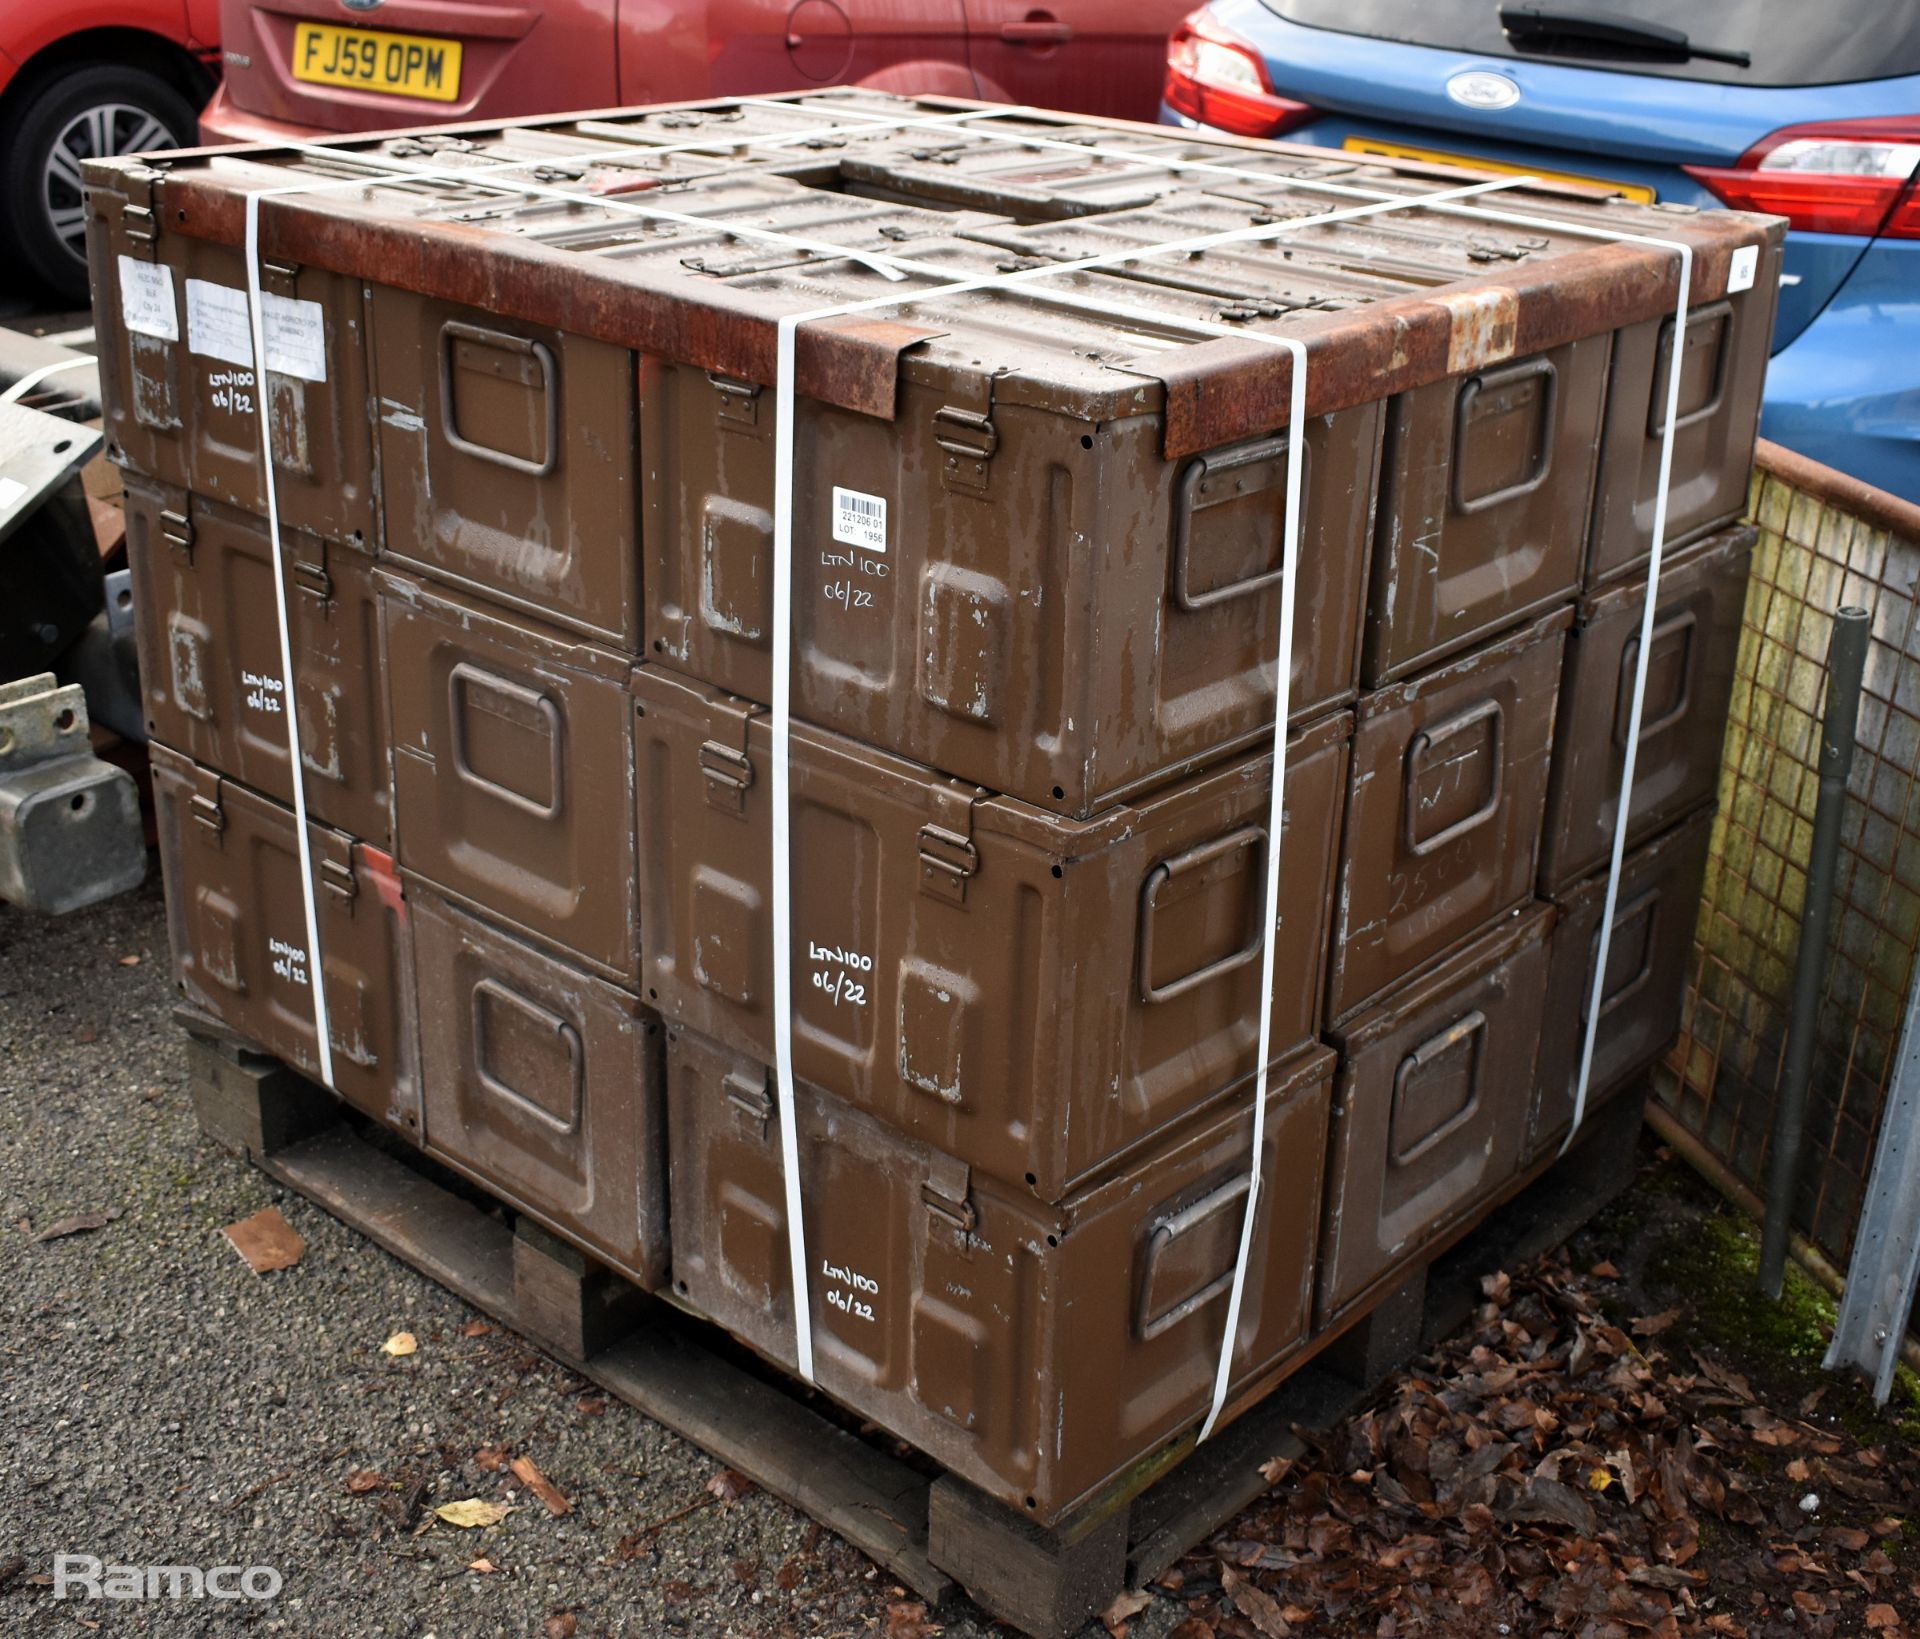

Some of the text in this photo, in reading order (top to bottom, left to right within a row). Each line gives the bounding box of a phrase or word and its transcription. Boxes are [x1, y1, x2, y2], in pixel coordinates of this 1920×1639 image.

[306, 31, 444, 89] FJ59 OPM
[212, 386, 254, 416] 06/22
[842, 511, 871, 527] 221206
[864, 530, 883, 543] 1956
[824, 580, 874, 611] 06/22
[247, 687, 281, 712] 06/22
[813, 970, 867, 1007] 06/22
[827, 1289, 875, 1321] 06/22
